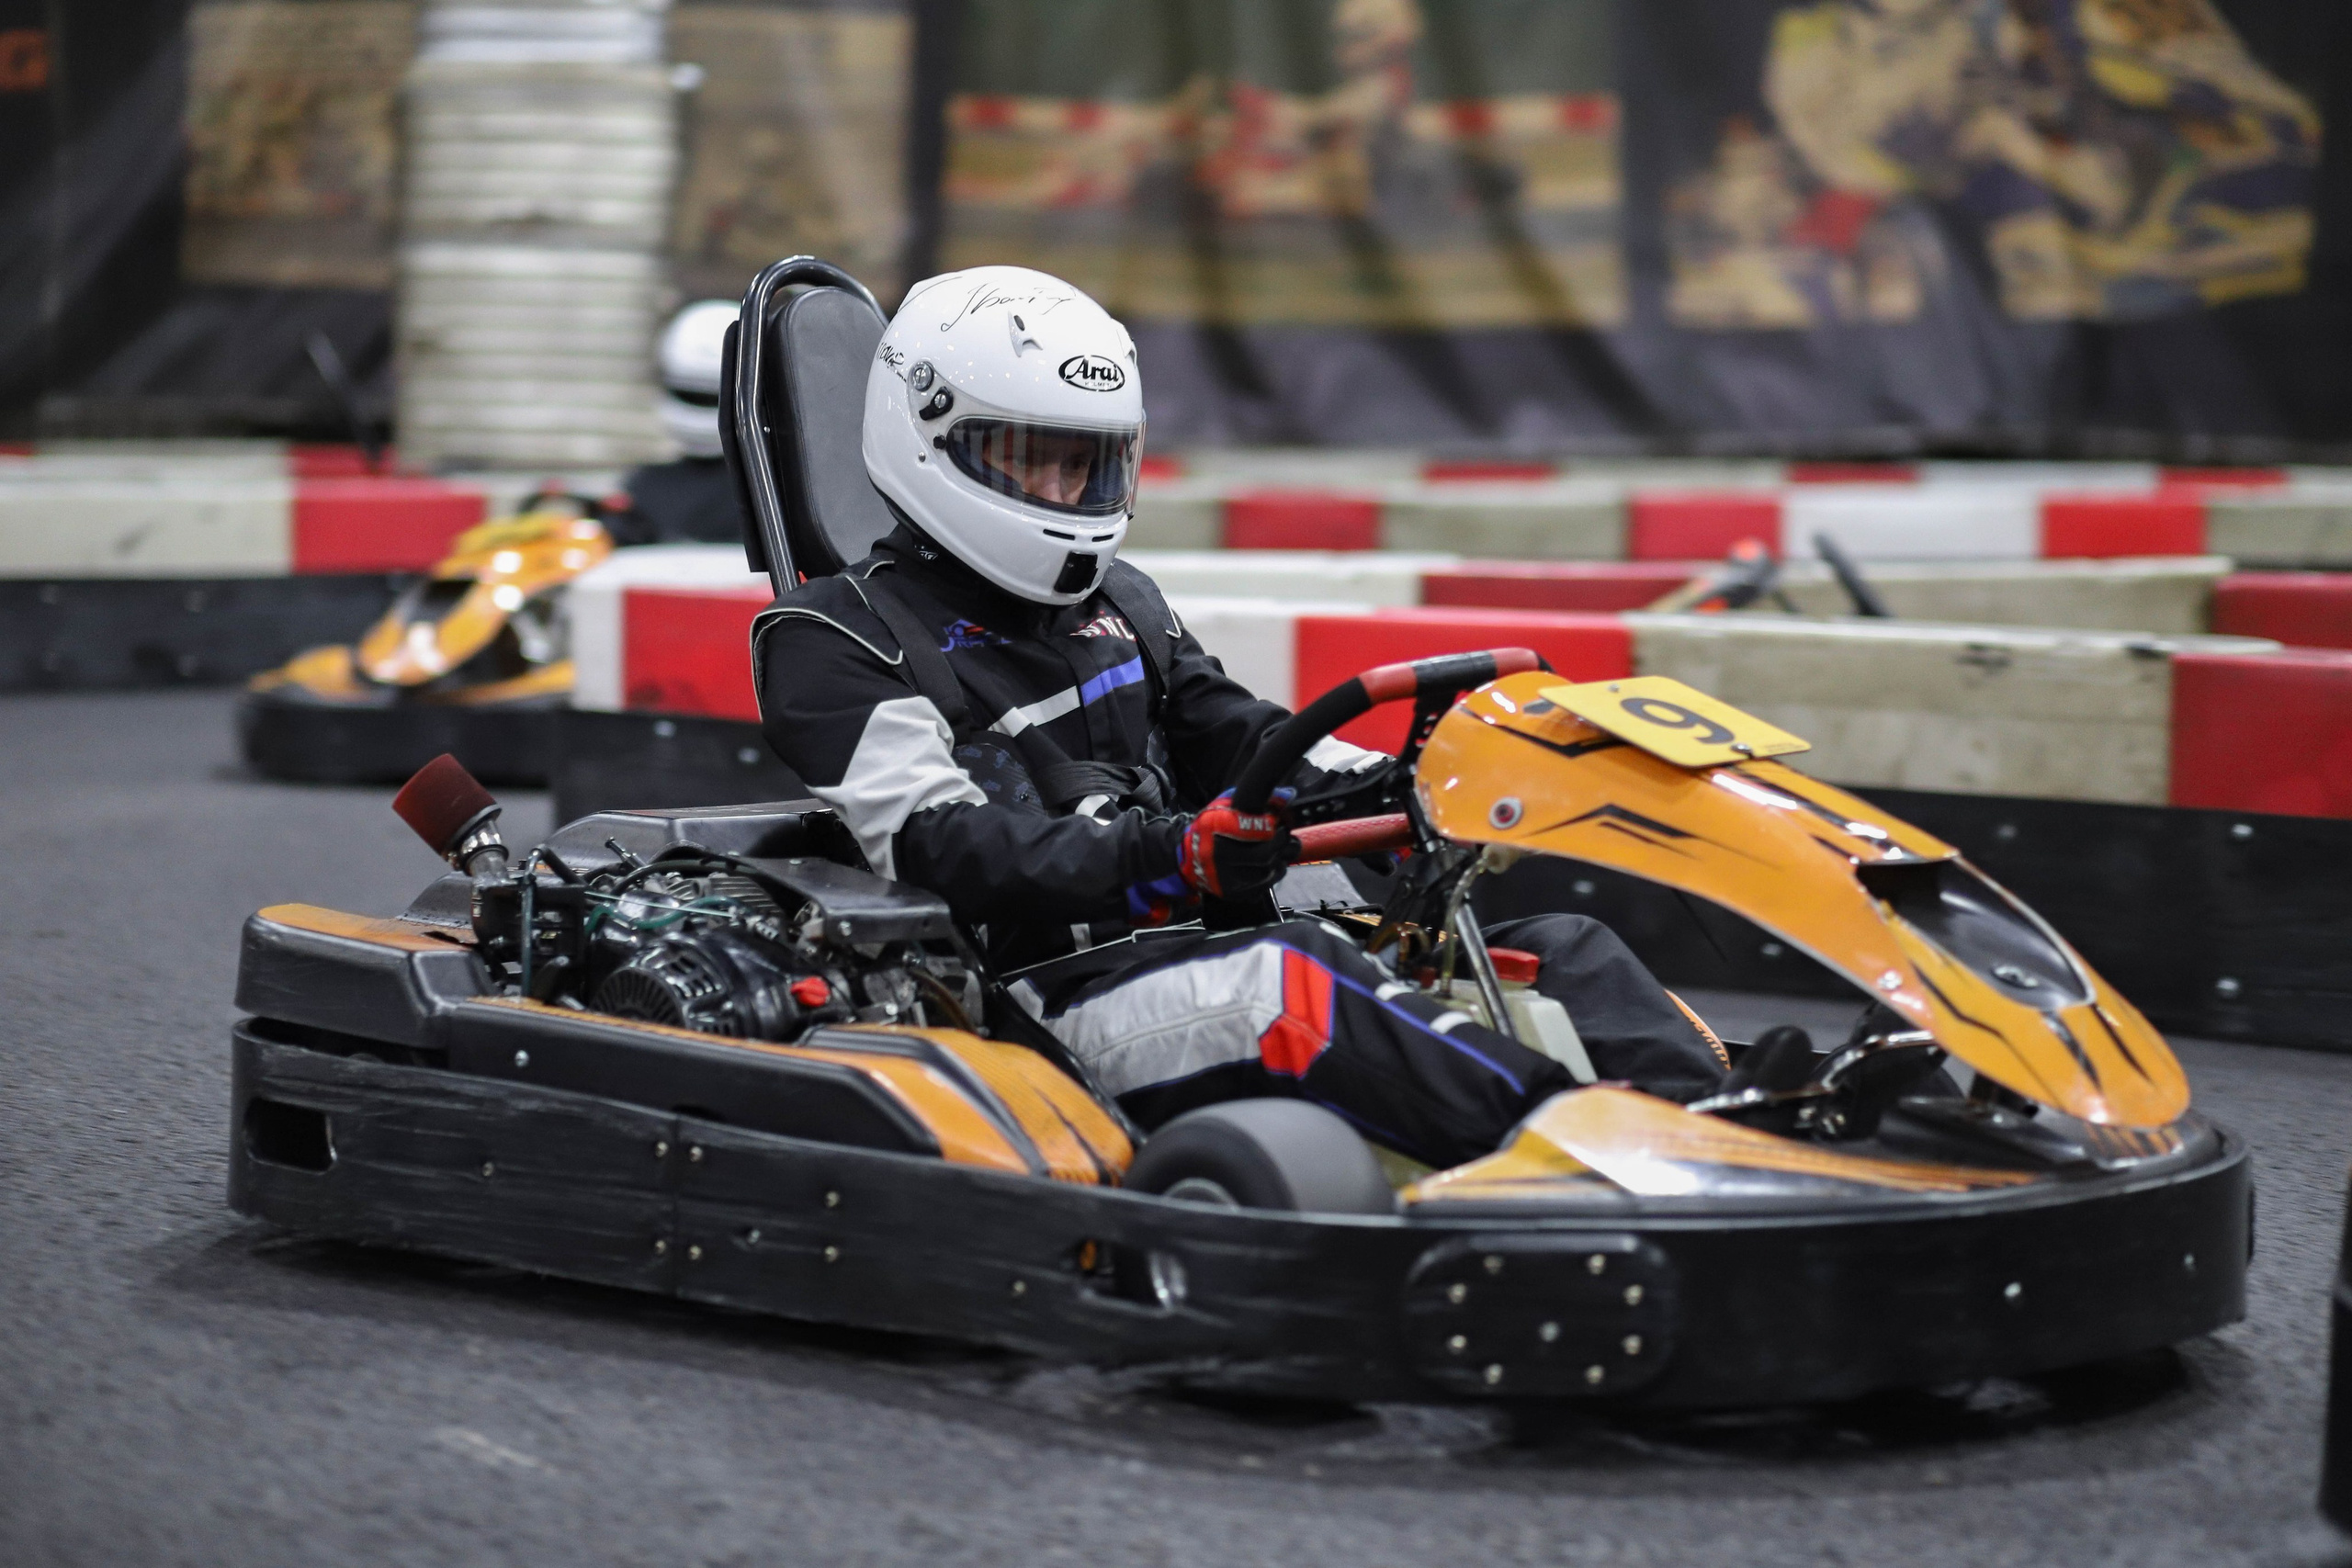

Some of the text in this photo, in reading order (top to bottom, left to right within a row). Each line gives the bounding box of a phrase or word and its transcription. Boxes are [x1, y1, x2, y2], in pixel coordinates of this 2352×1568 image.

[1065, 357, 1120, 382] Arai
[1620, 697, 1736, 745] 9
[1238, 815, 1272, 831] WNL
